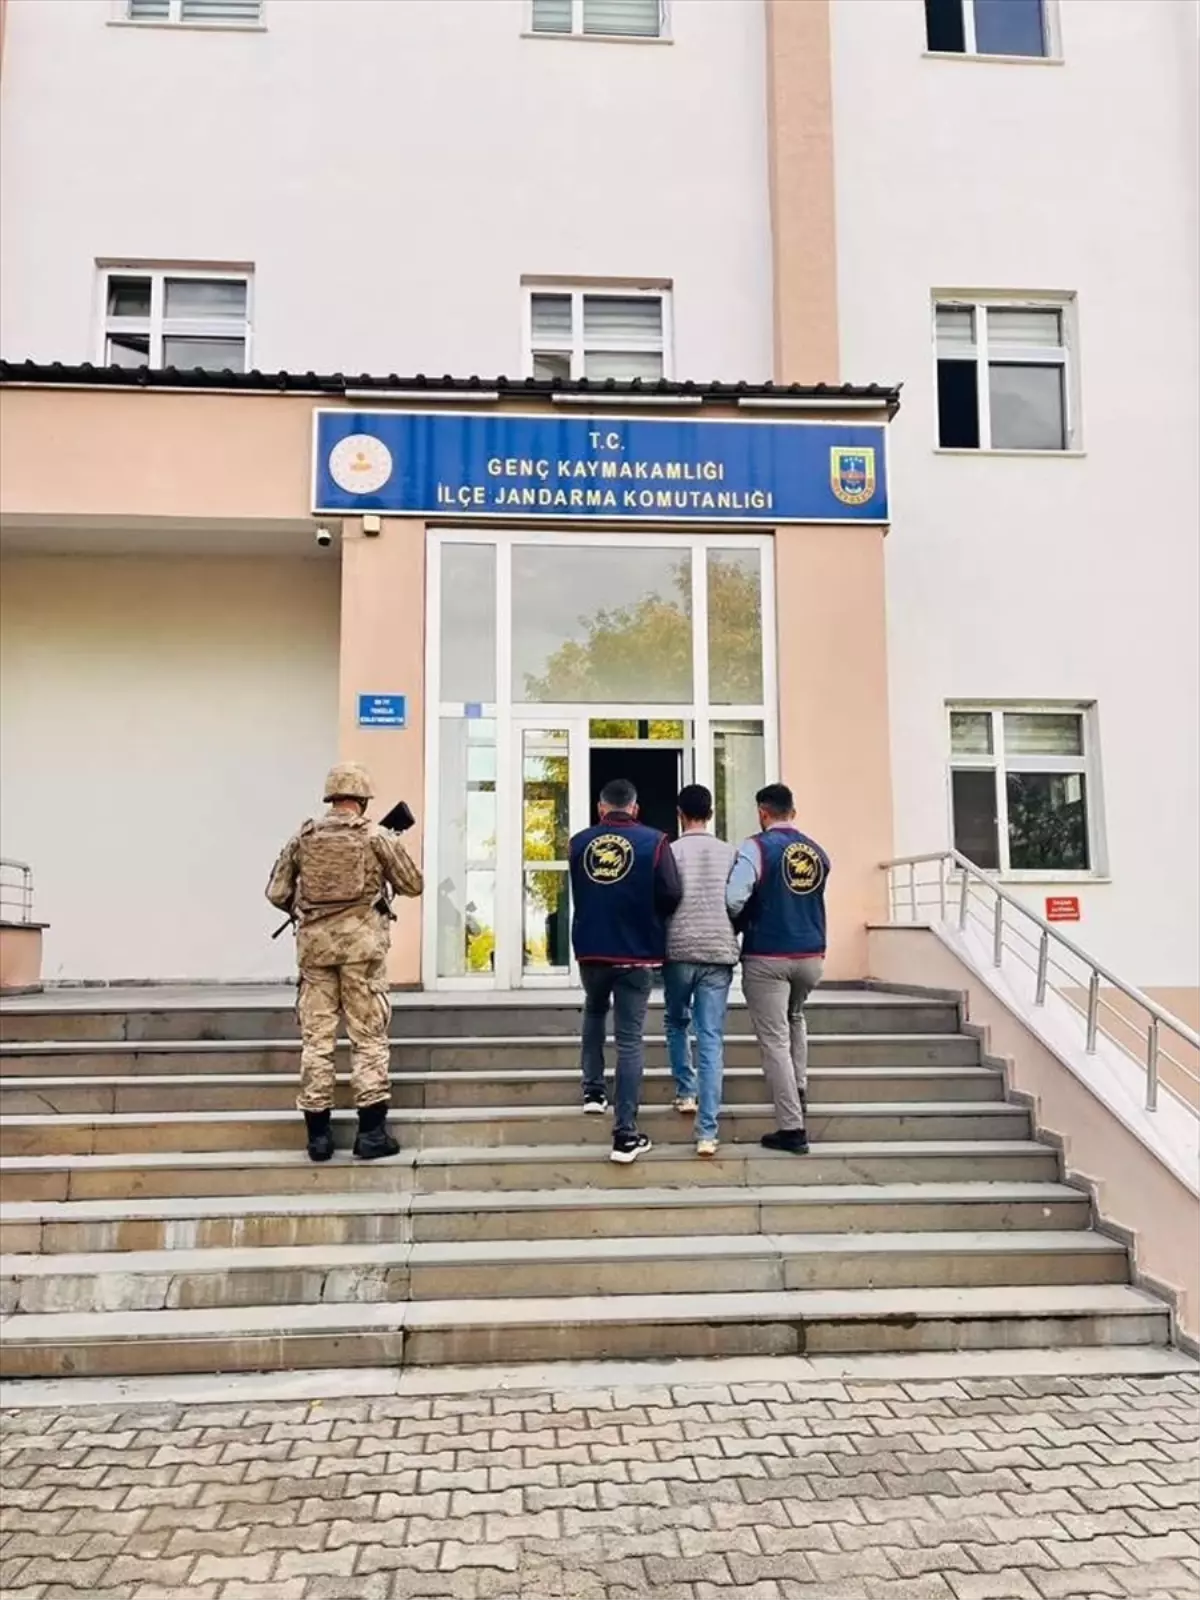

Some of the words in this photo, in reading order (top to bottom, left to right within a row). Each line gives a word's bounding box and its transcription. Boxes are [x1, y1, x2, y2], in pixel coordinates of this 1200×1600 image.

[589, 432, 625, 450] T.C.
[488, 458, 549, 480] GENÇ
[558, 460, 724, 481] KAYMAKAMLIĞI
[437, 482, 485, 507] İLÇE
[495, 487, 616, 506] JANDARMA
[624, 489, 773, 509] KOMUTANLIĞI
